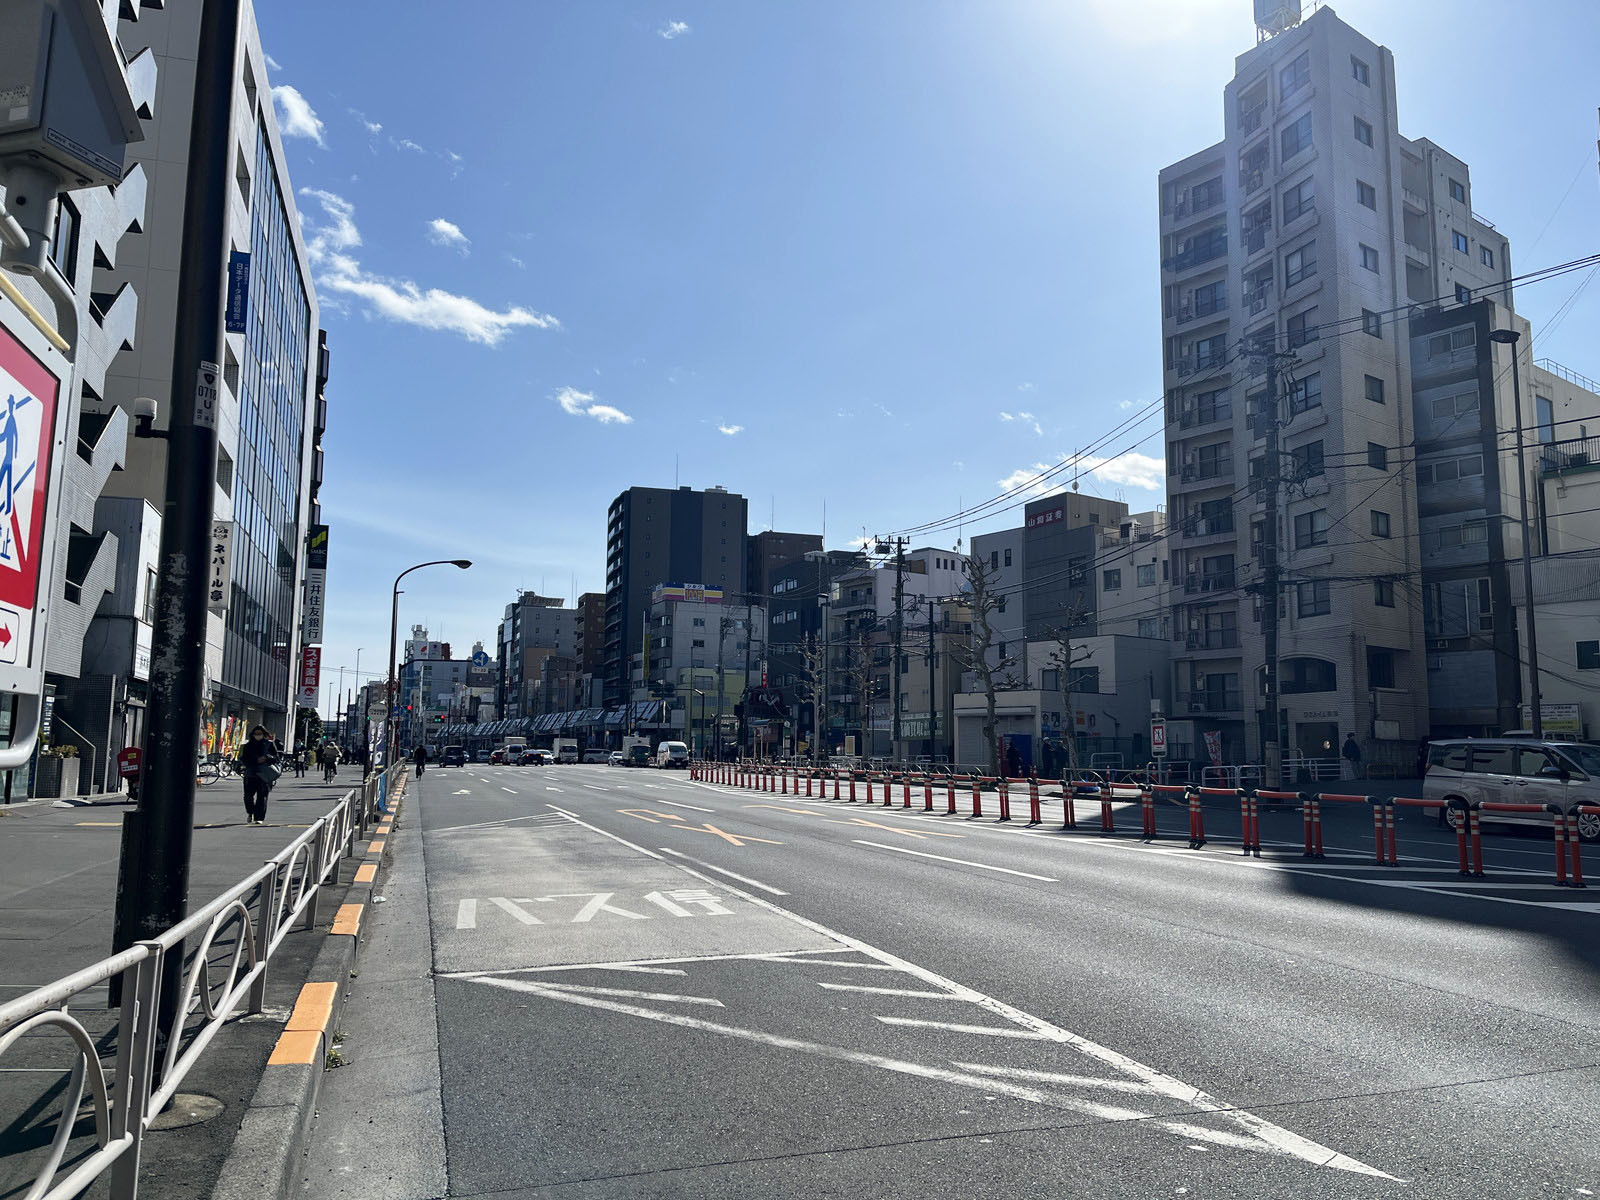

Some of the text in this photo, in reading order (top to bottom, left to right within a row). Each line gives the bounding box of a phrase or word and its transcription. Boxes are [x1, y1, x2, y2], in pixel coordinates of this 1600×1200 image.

[198, 386, 216, 400] 0718
[203, 400, 212, 409] U
[0, 526, 11, 561] 止
[307, 573, 322, 639] 三井住友銀行
[304, 649, 317, 686] スギ薬局
[456, 889, 737, 930] バス停
